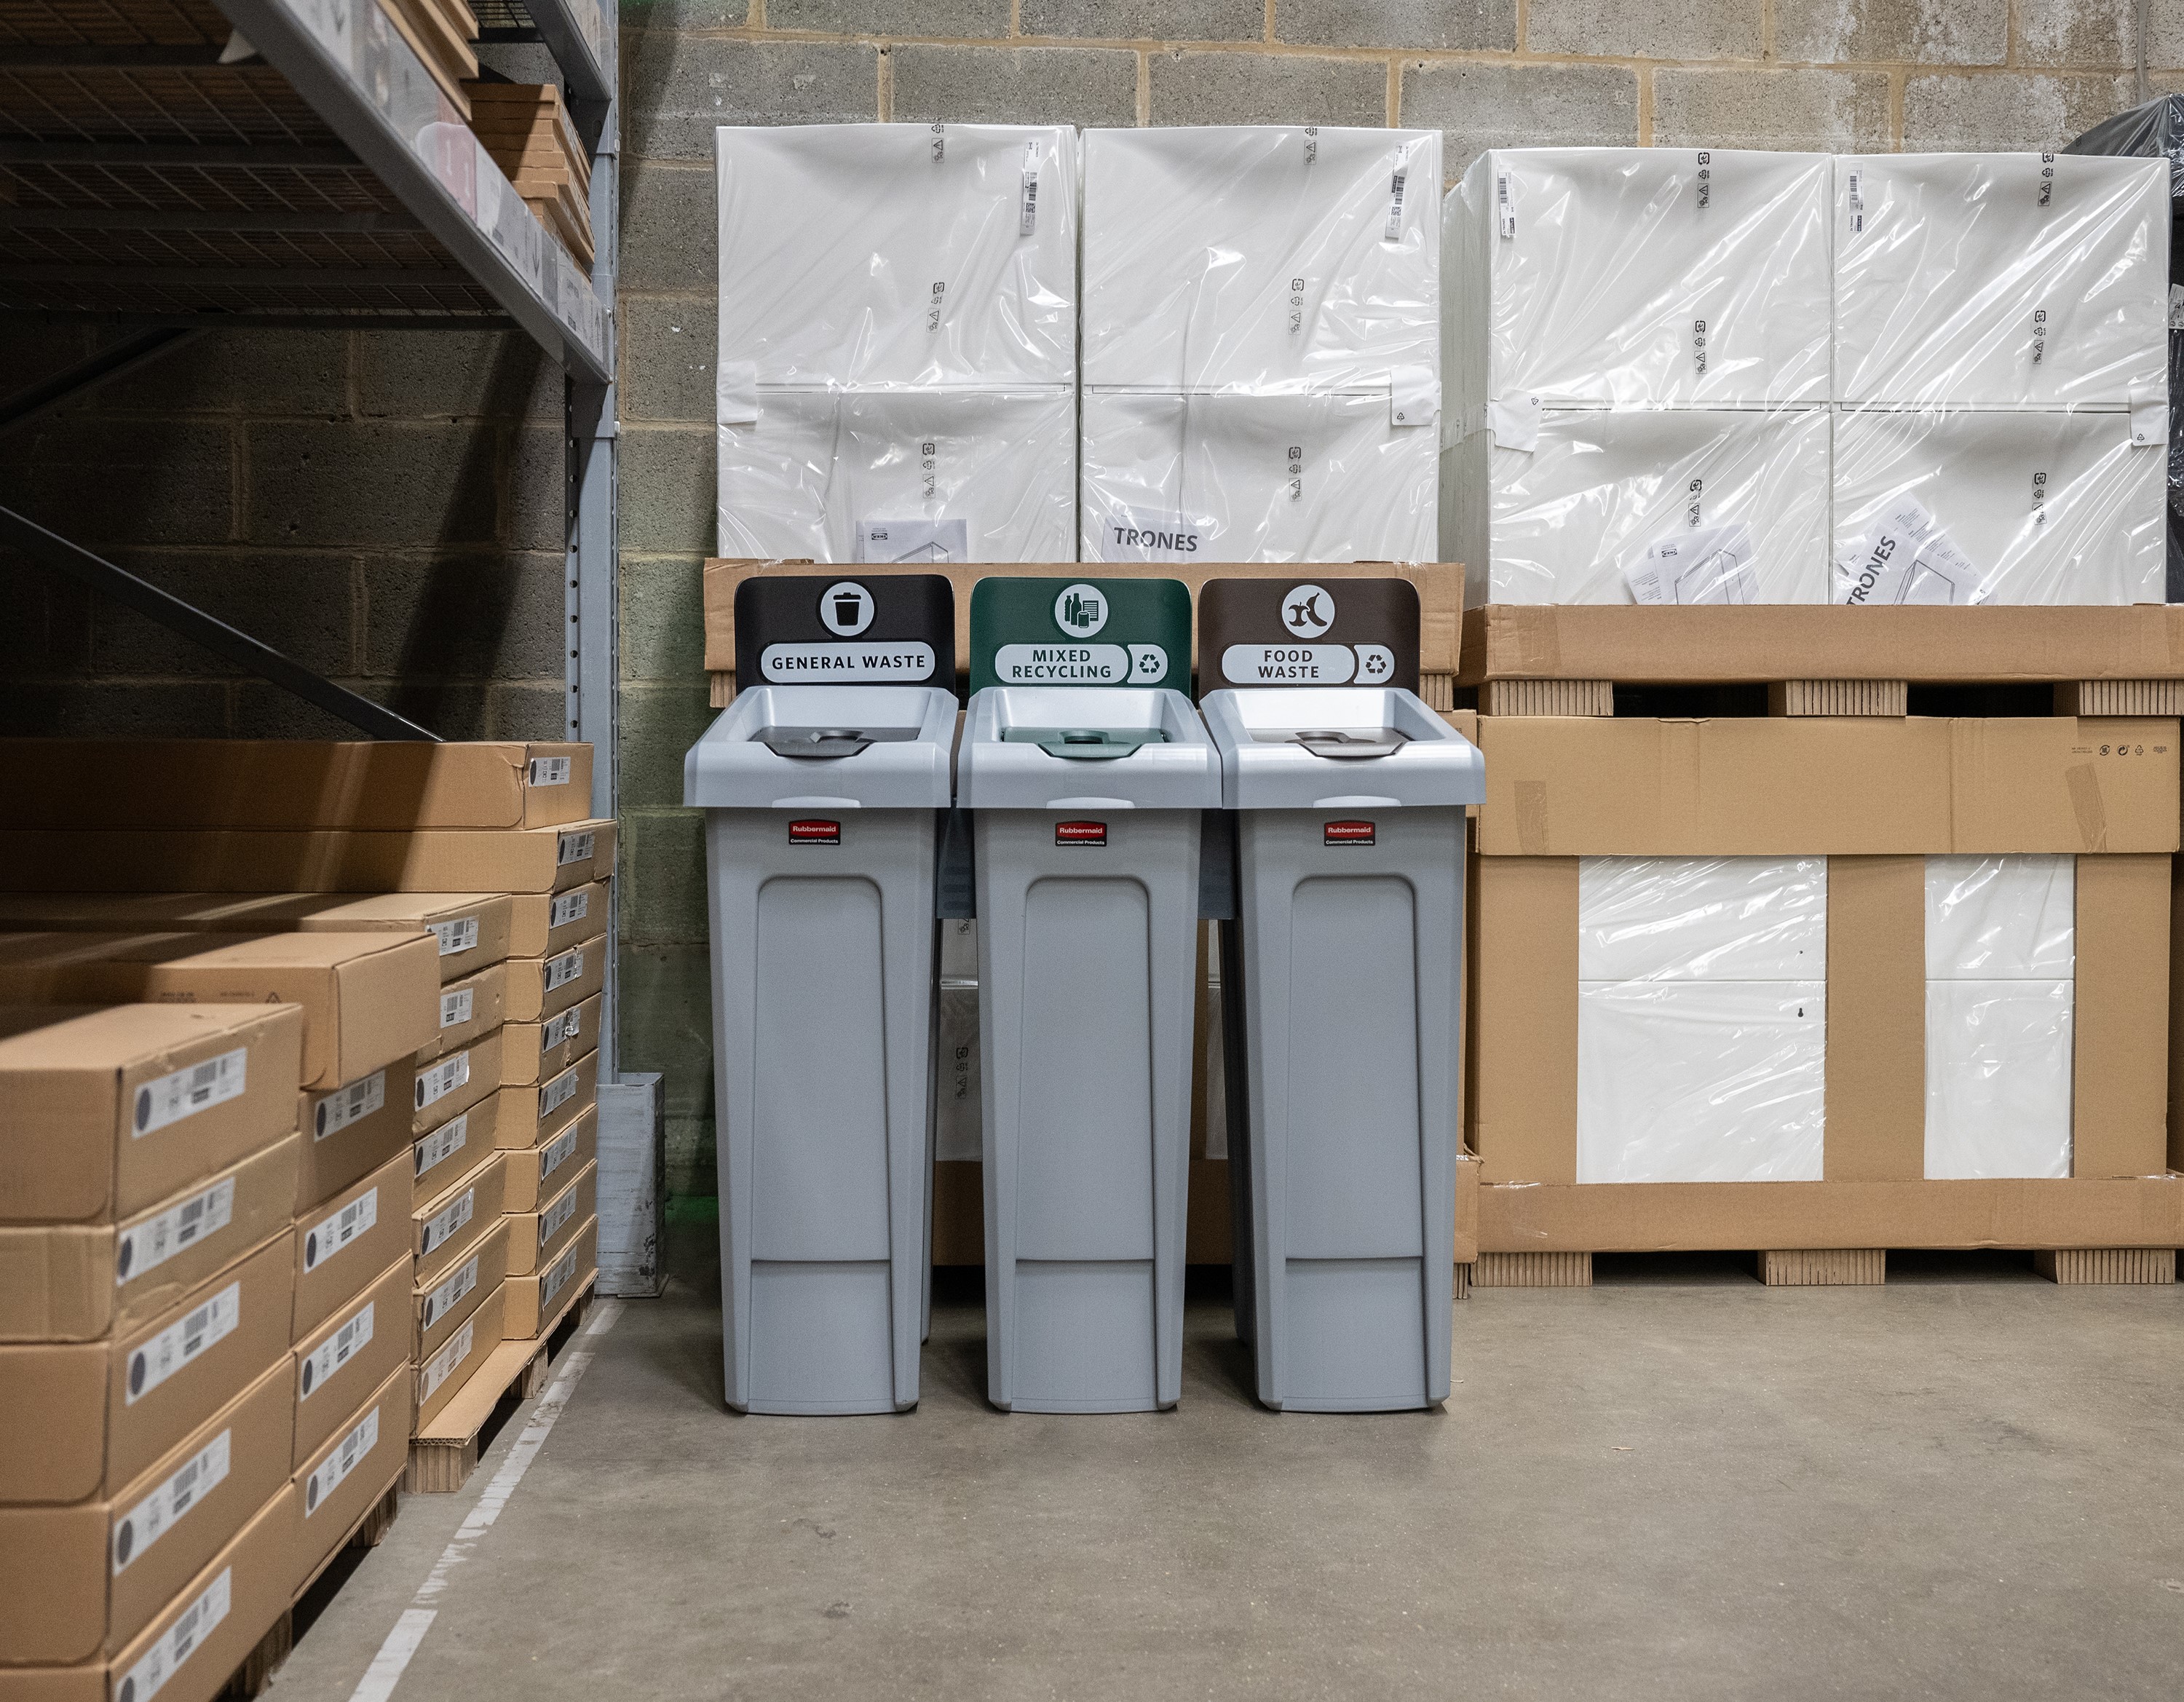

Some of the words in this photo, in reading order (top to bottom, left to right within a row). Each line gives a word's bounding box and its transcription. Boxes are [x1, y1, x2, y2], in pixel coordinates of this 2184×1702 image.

[1114, 527, 1198, 552] TRONES
[1032, 649, 1091, 662] MIXED
[1264, 650, 1313, 662] FOOD
[772, 656, 855, 670] GENERAL
[862, 655, 925, 668] WASTE
[1012, 665, 1111, 678] RECYCLING
[1258, 666, 1319, 678] WASTE
